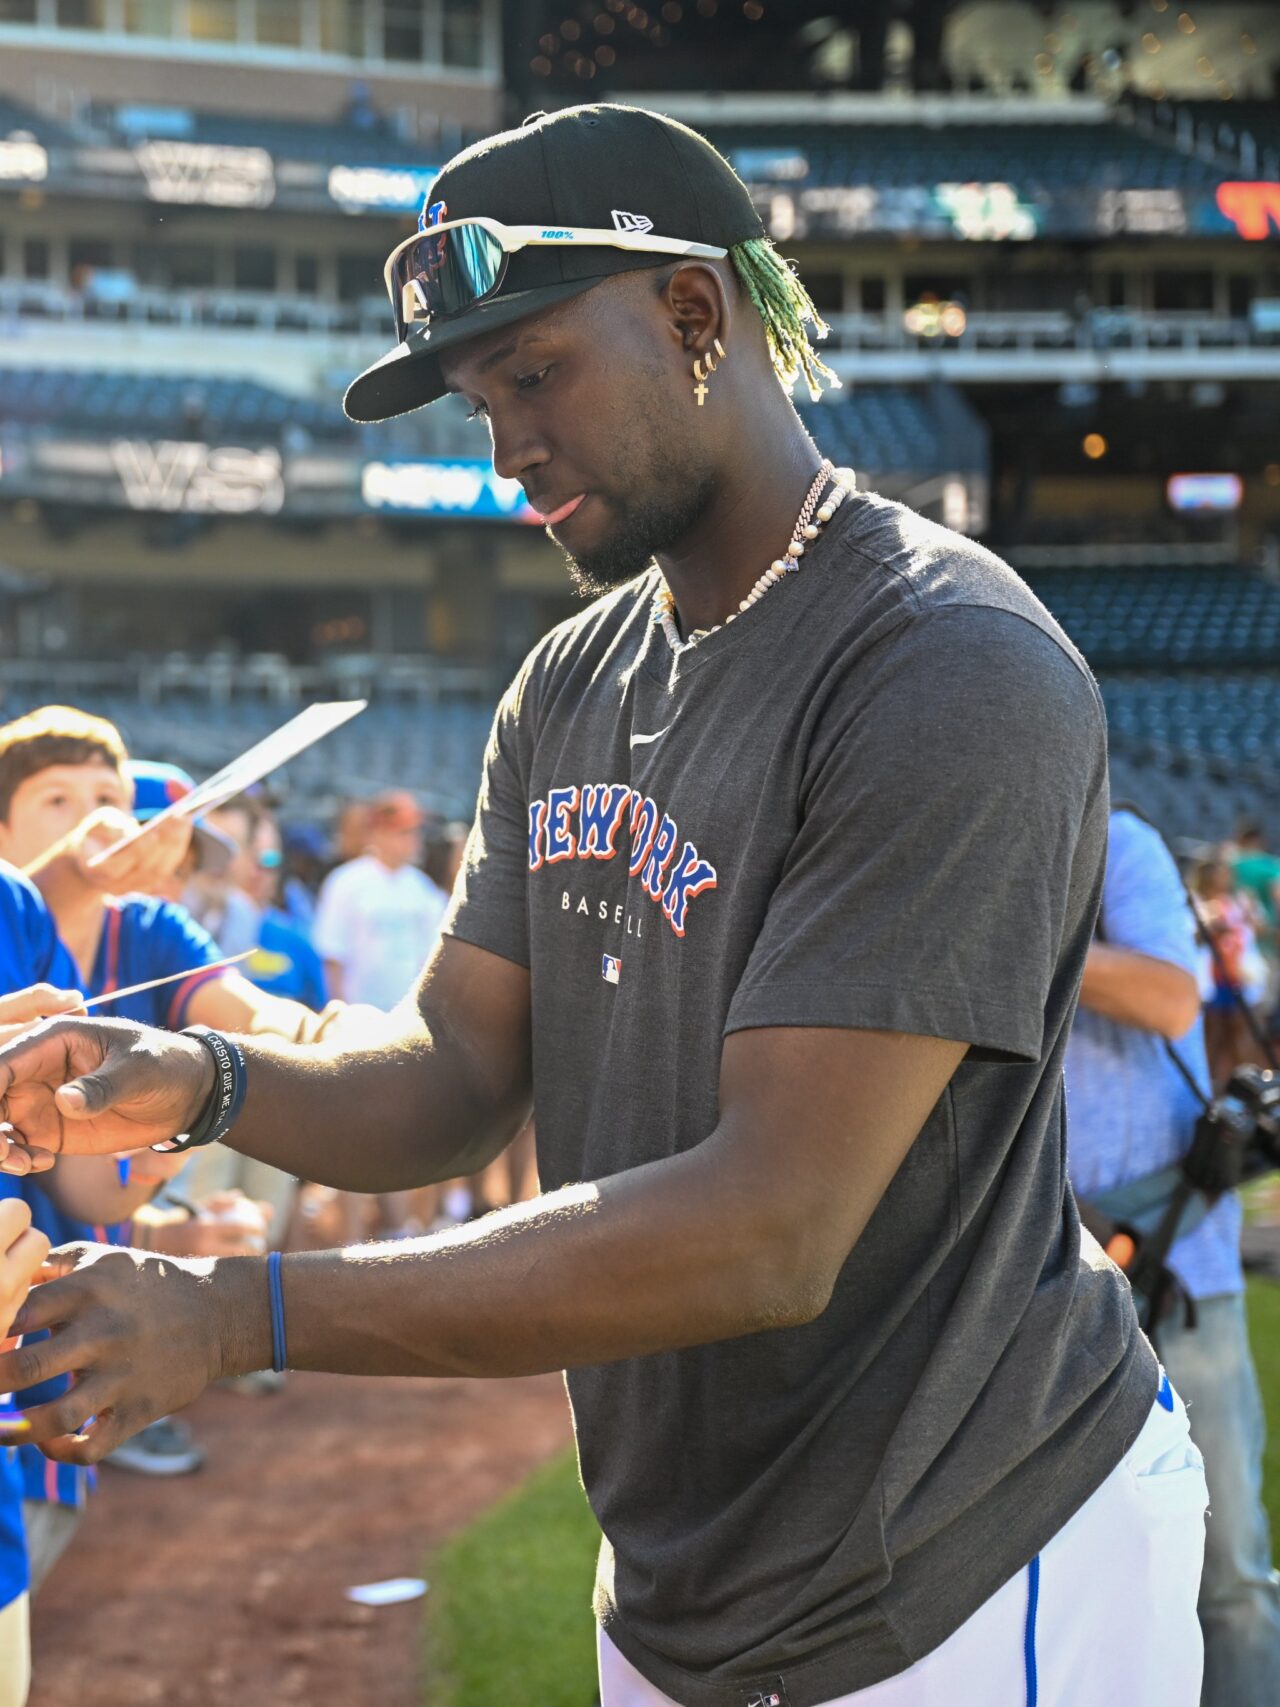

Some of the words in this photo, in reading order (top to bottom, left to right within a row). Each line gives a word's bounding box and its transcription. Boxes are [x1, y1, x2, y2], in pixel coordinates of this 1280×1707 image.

[540, 230, 574, 240] 100%
[628, 789, 718, 938] ORK
[207, 1035, 232, 1069] CRISTO
[222, 1071, 234, 1093] QUE
